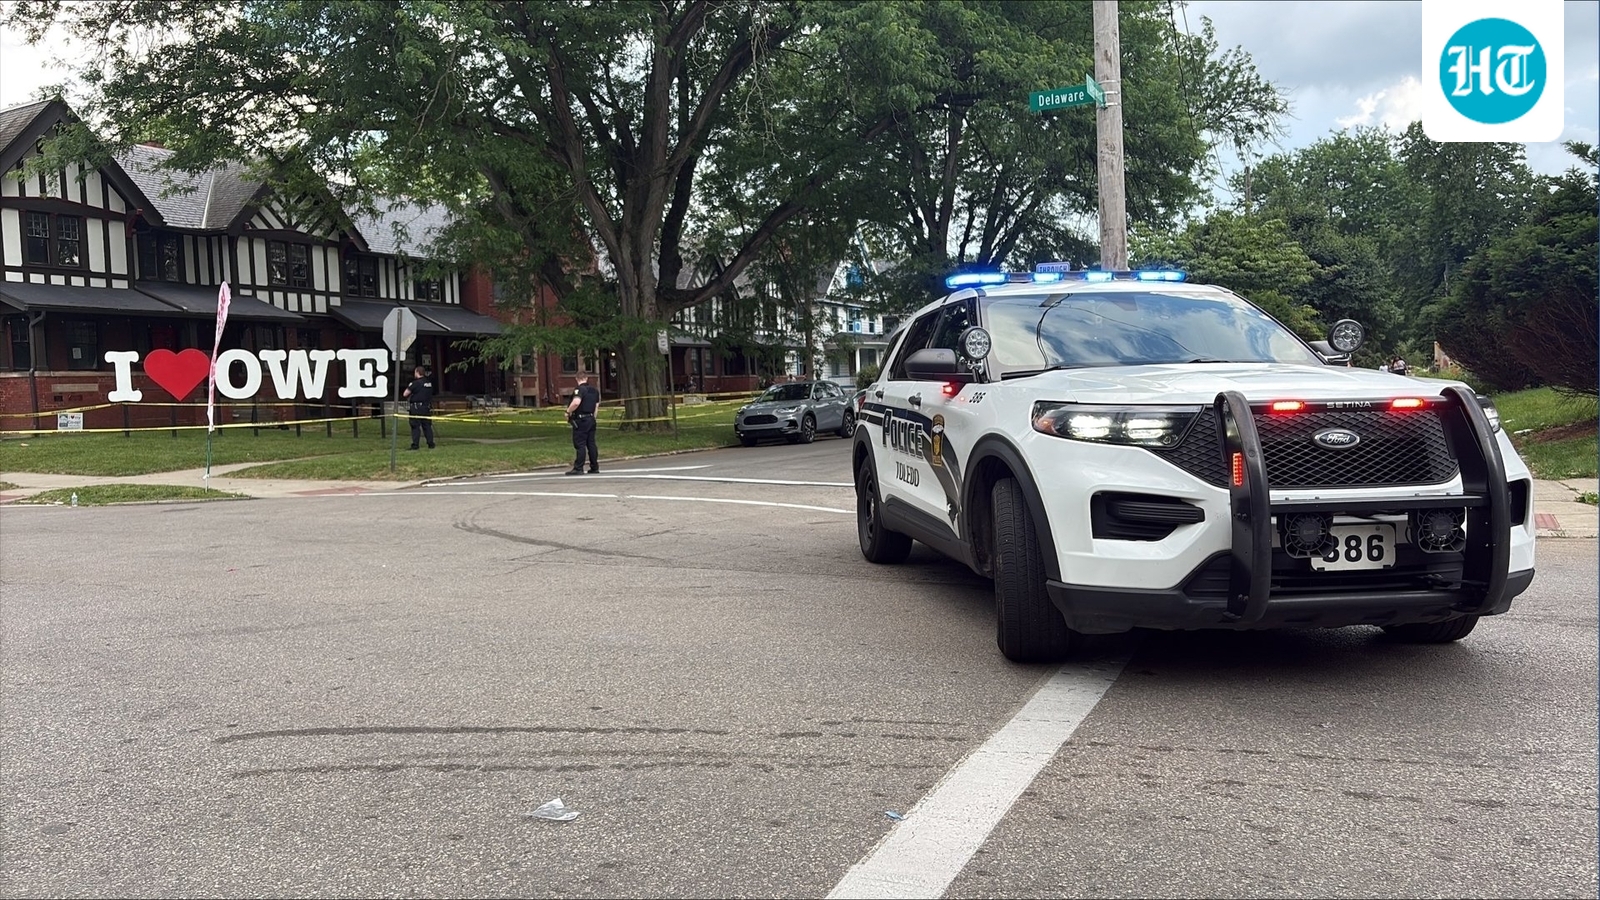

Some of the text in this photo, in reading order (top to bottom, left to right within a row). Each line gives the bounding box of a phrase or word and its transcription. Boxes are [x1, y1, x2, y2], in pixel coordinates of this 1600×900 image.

[1038, 91, 1085, 107] Delaware
[104, 348, 389, 402] I OWE
[1326, 401, 1372, 409] SETINA
[1327, 433, 1350, 443] Ford
[895, 461, 920, 487] TOLEDO
